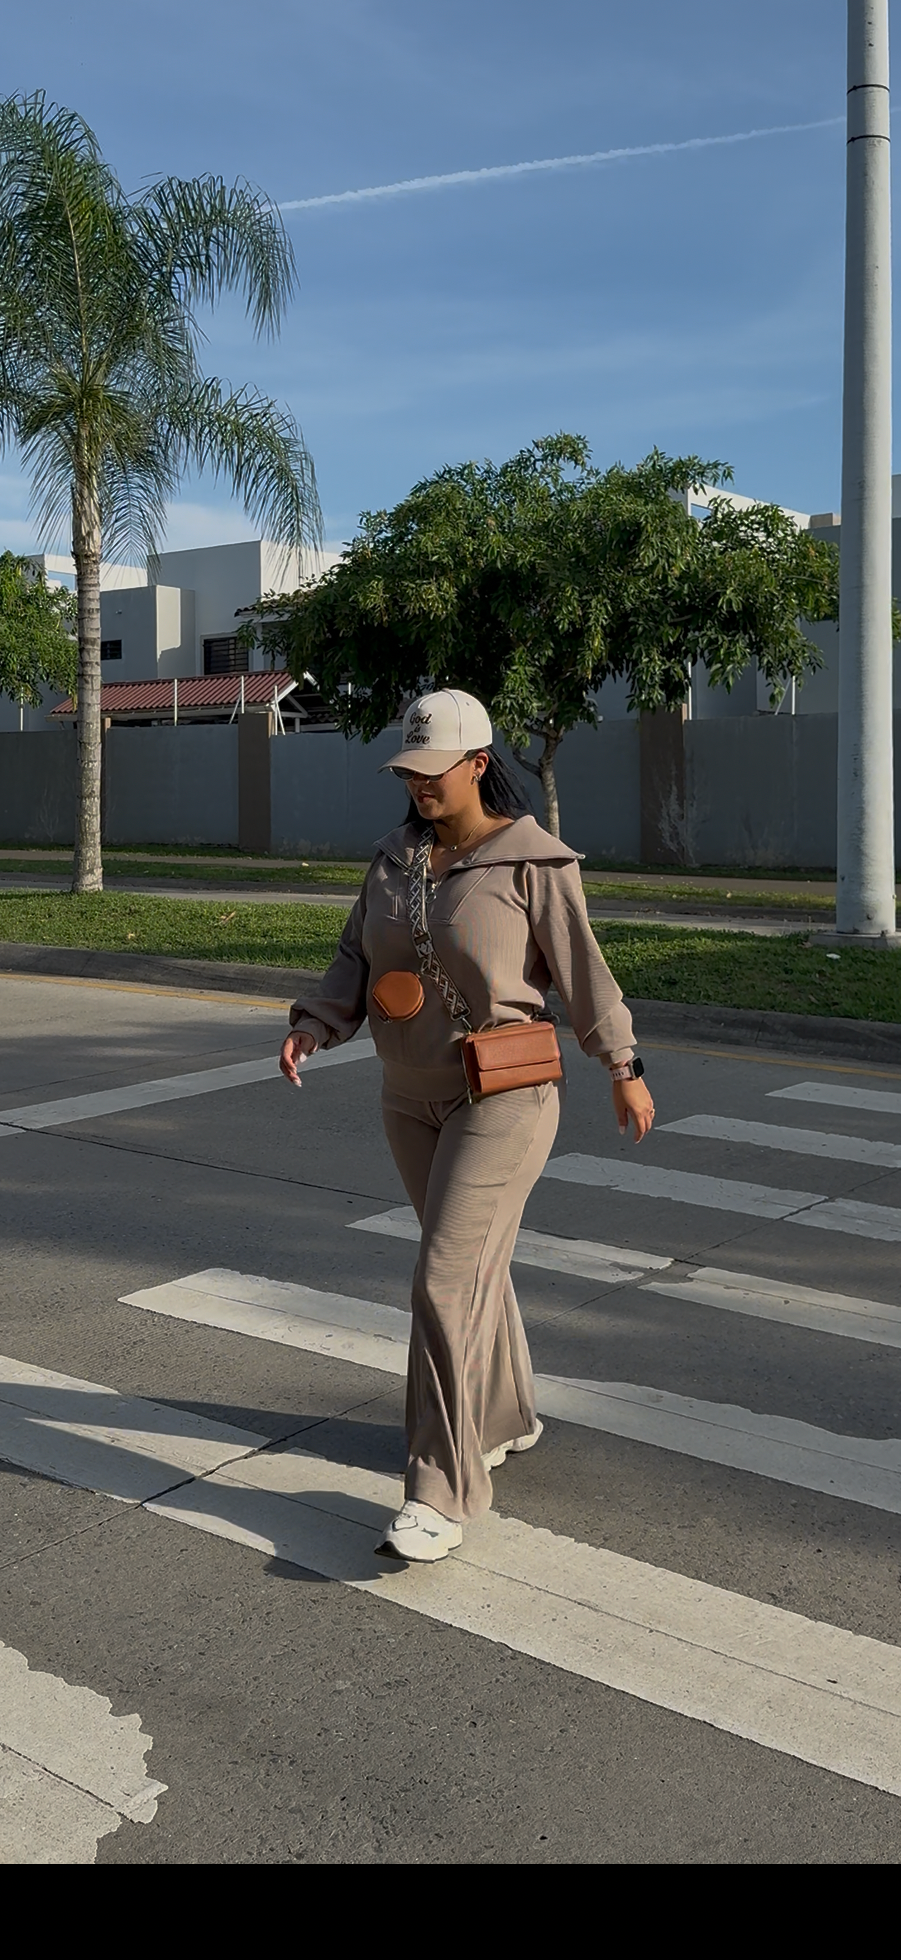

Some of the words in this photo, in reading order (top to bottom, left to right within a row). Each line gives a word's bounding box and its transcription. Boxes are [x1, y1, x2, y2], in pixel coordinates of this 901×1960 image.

[410, 712, 432, 725] God
[414, 724, 421, 732] is
[405, 731, 430, 745] Love
